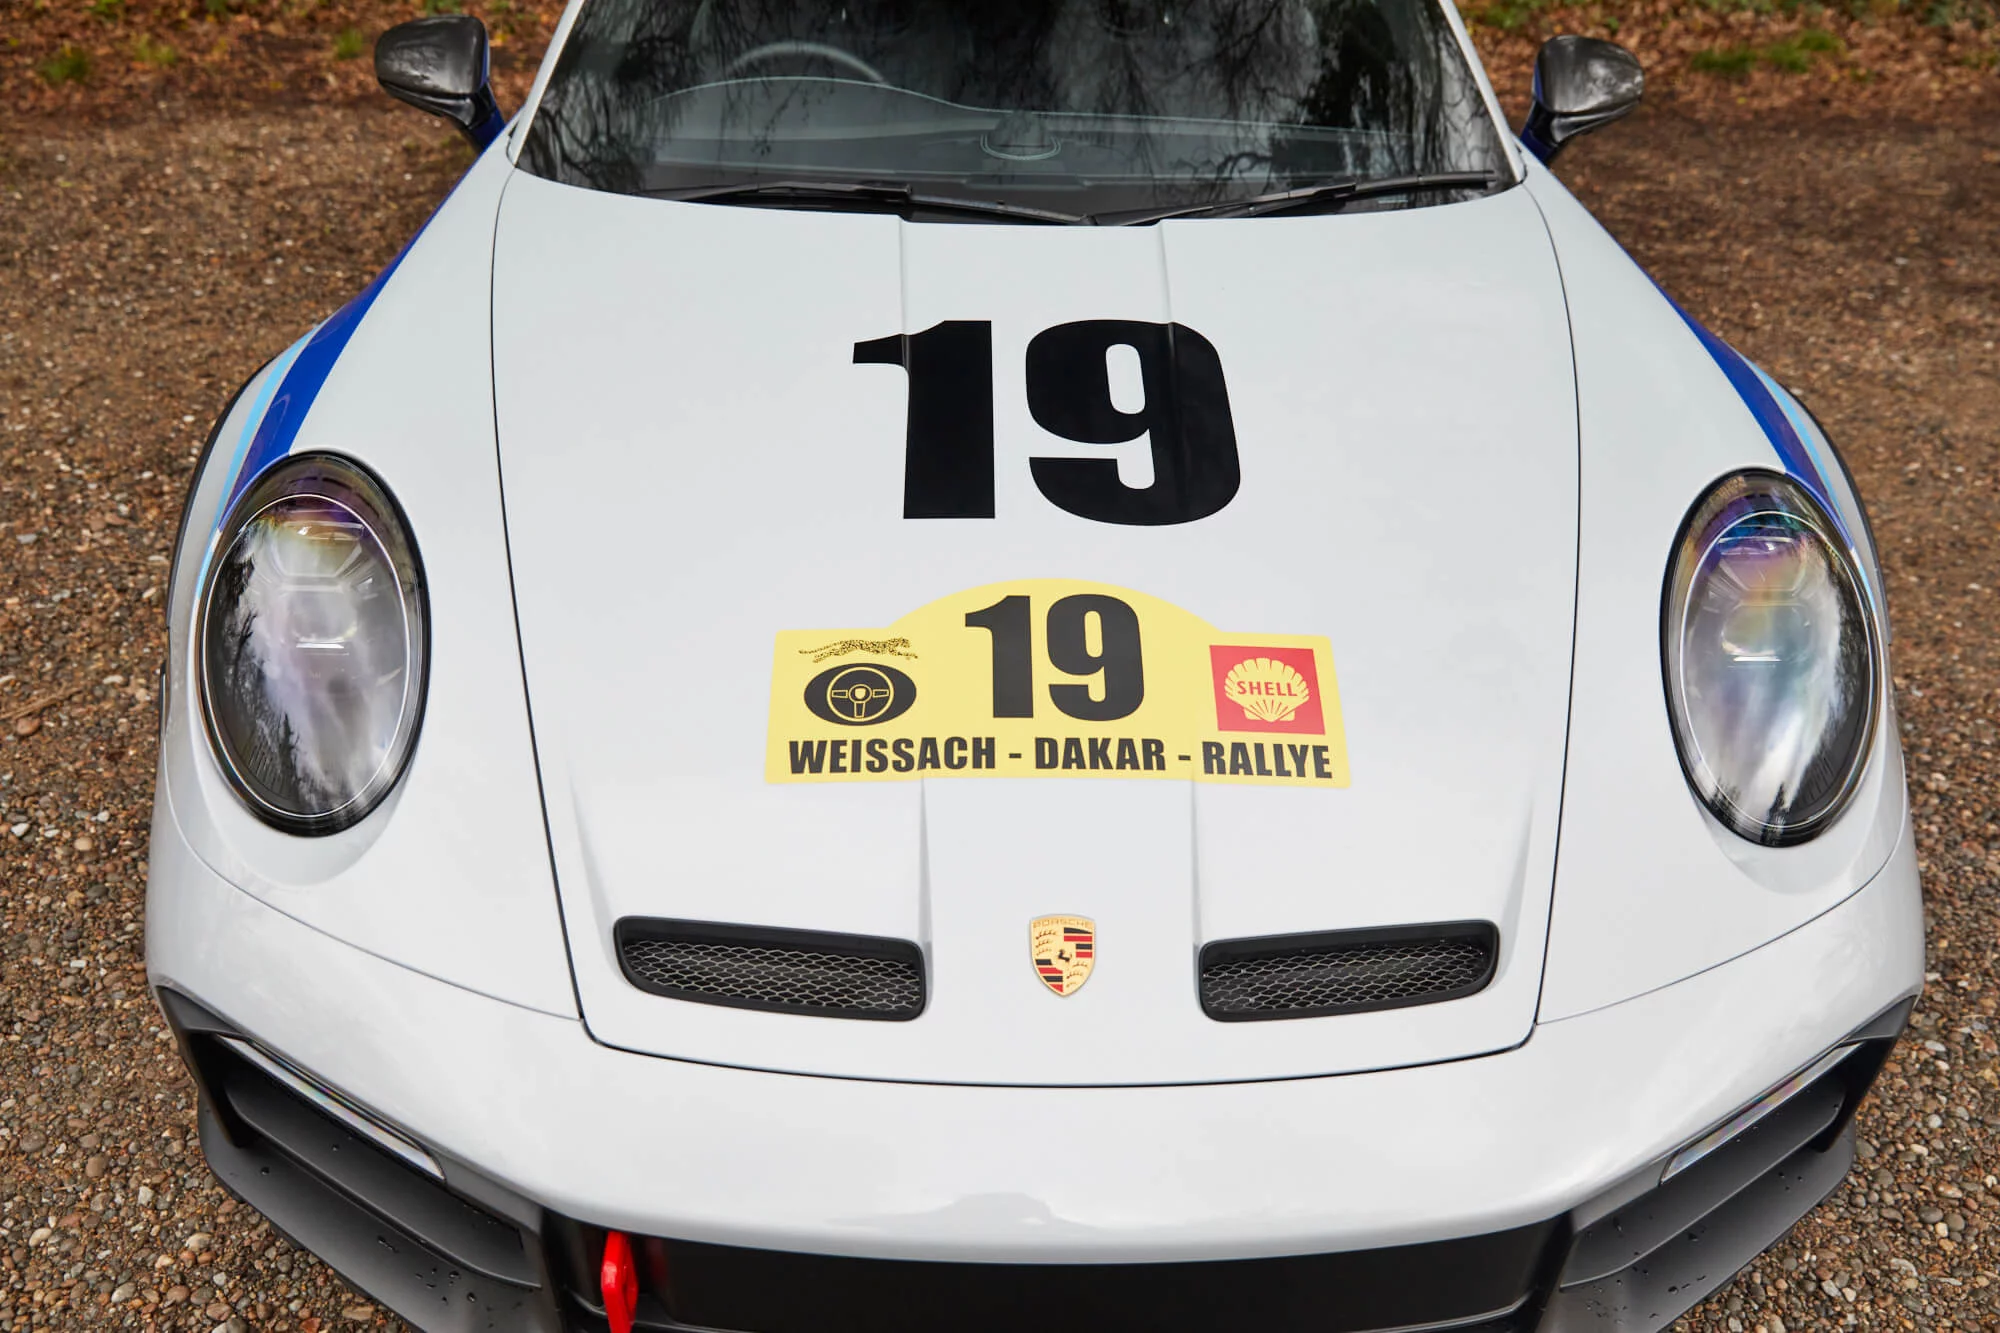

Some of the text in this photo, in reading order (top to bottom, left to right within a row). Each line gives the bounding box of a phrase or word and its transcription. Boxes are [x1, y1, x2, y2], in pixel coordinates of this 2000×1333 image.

[853, 320, 1240, 526] 19
[965, 593, 1145, 721] 19
[1236, 680, 1298, 697] SHELL
[789, 736, 996, 774] WEISSACH
[1034, 737, 1166, 771] DAKAR
[1202, 741, 1332, 778] RALLYE
